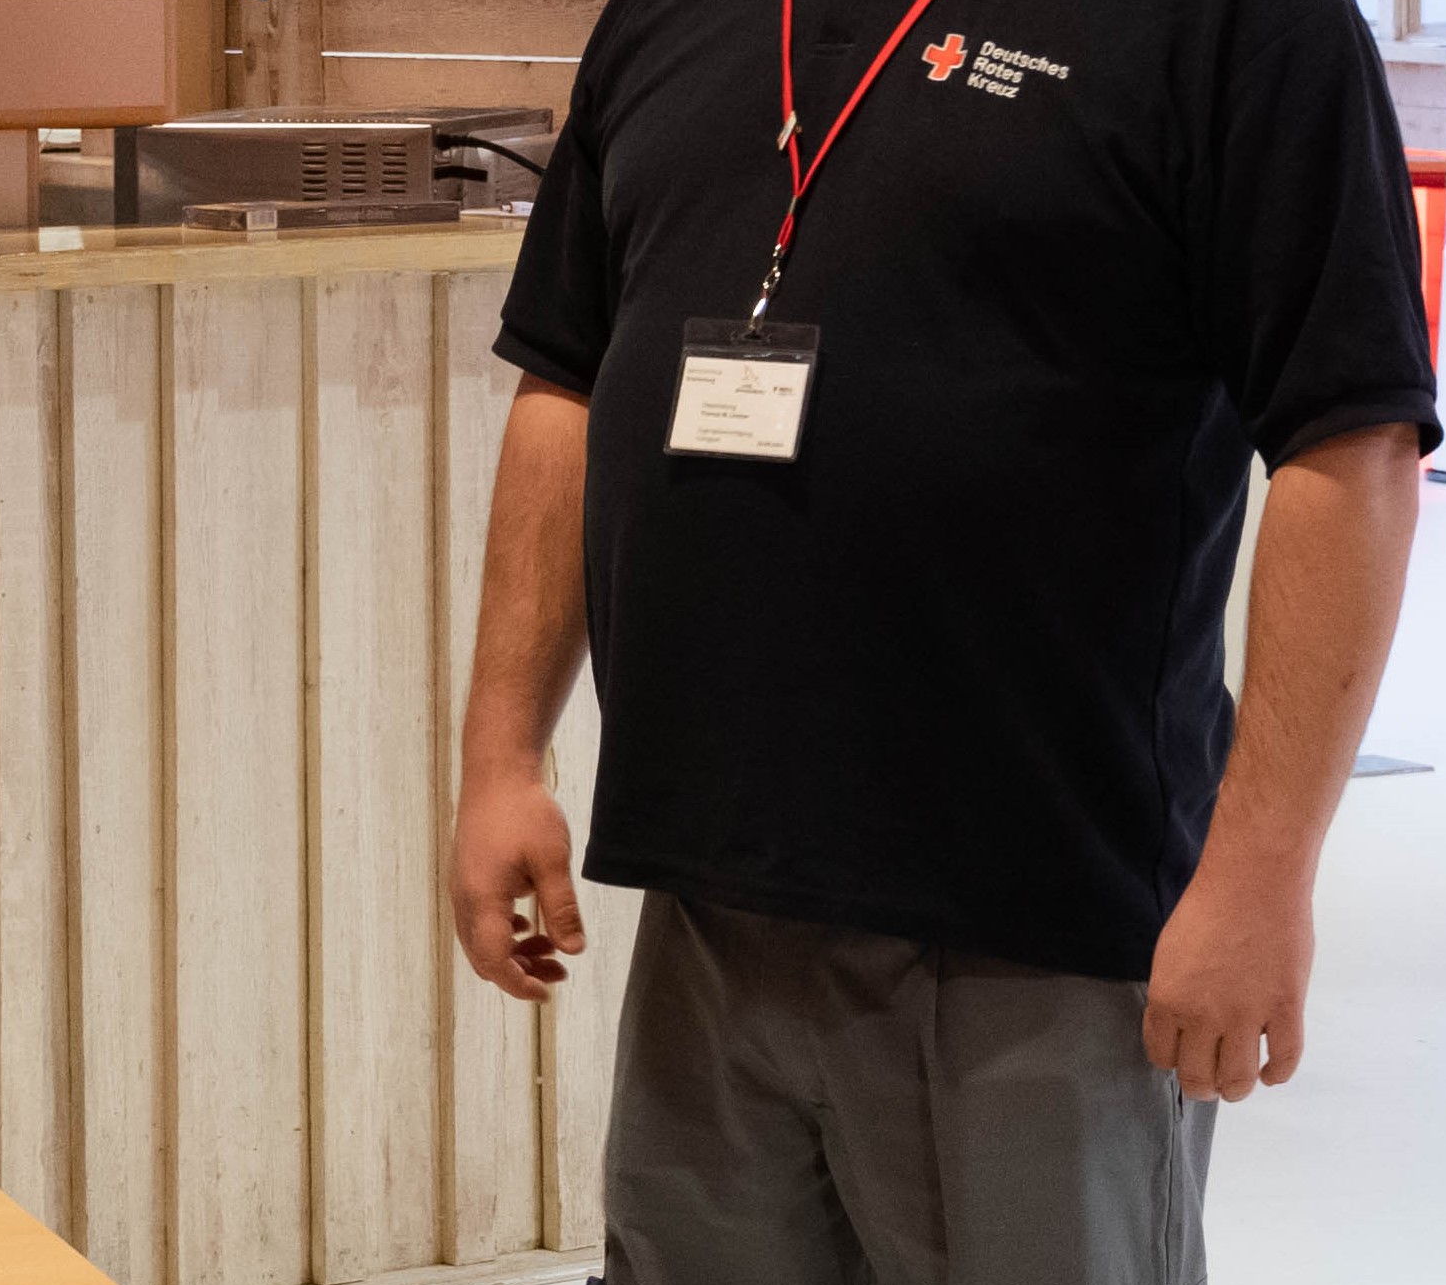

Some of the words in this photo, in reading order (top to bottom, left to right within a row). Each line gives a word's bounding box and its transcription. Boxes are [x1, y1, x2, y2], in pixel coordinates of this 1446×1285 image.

[973, 56, 1024, 84] Rotes
[980, 40, 1070, 80] Deutsches
[967, 72, 1020, 99] Kreuz
